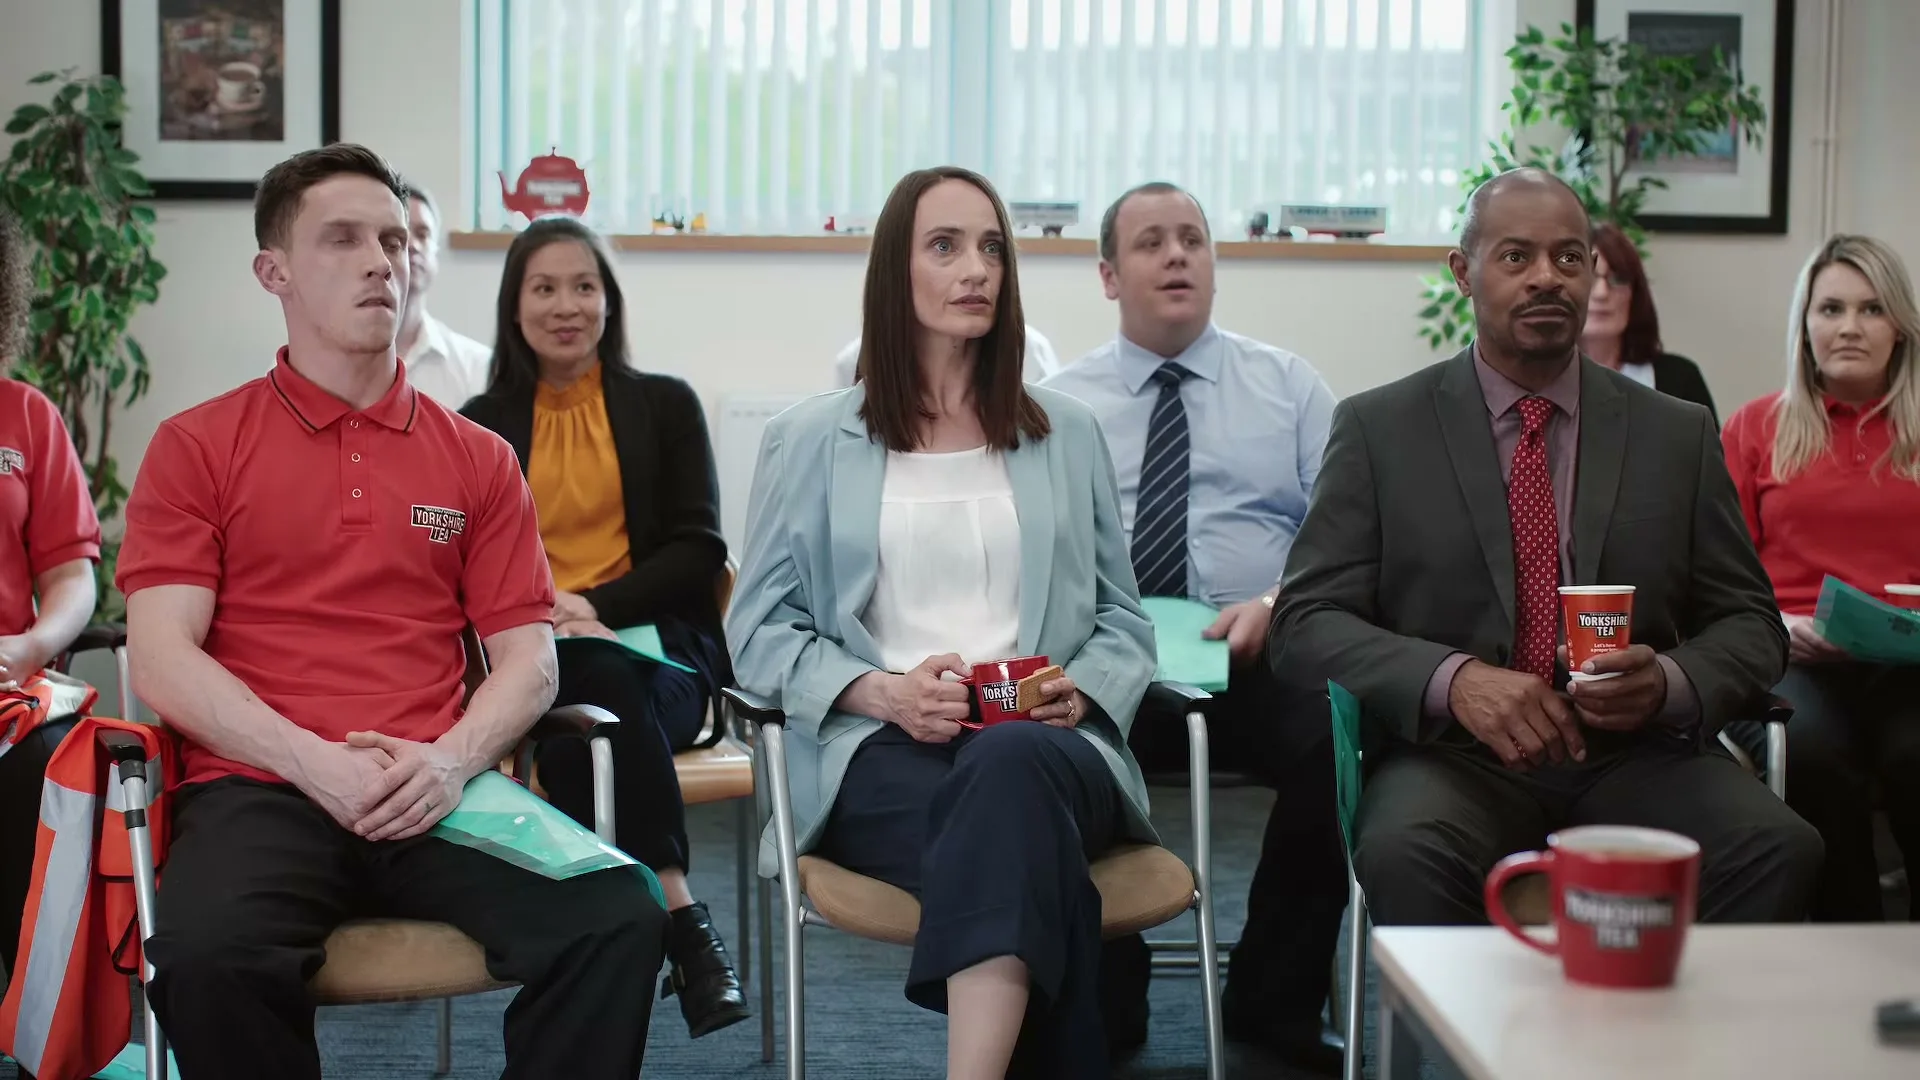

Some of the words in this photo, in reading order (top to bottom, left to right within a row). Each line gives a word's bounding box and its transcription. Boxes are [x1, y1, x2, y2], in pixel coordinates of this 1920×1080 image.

[416, 508, 465, 531] YORKSHIRE
[433, 526, 449, 541] TEA
[1578, 614, 1628, 627] YORKSHIRE
[1596, 627, 1614, 636] TEA
[1001, 697, 1016, 710] TE
